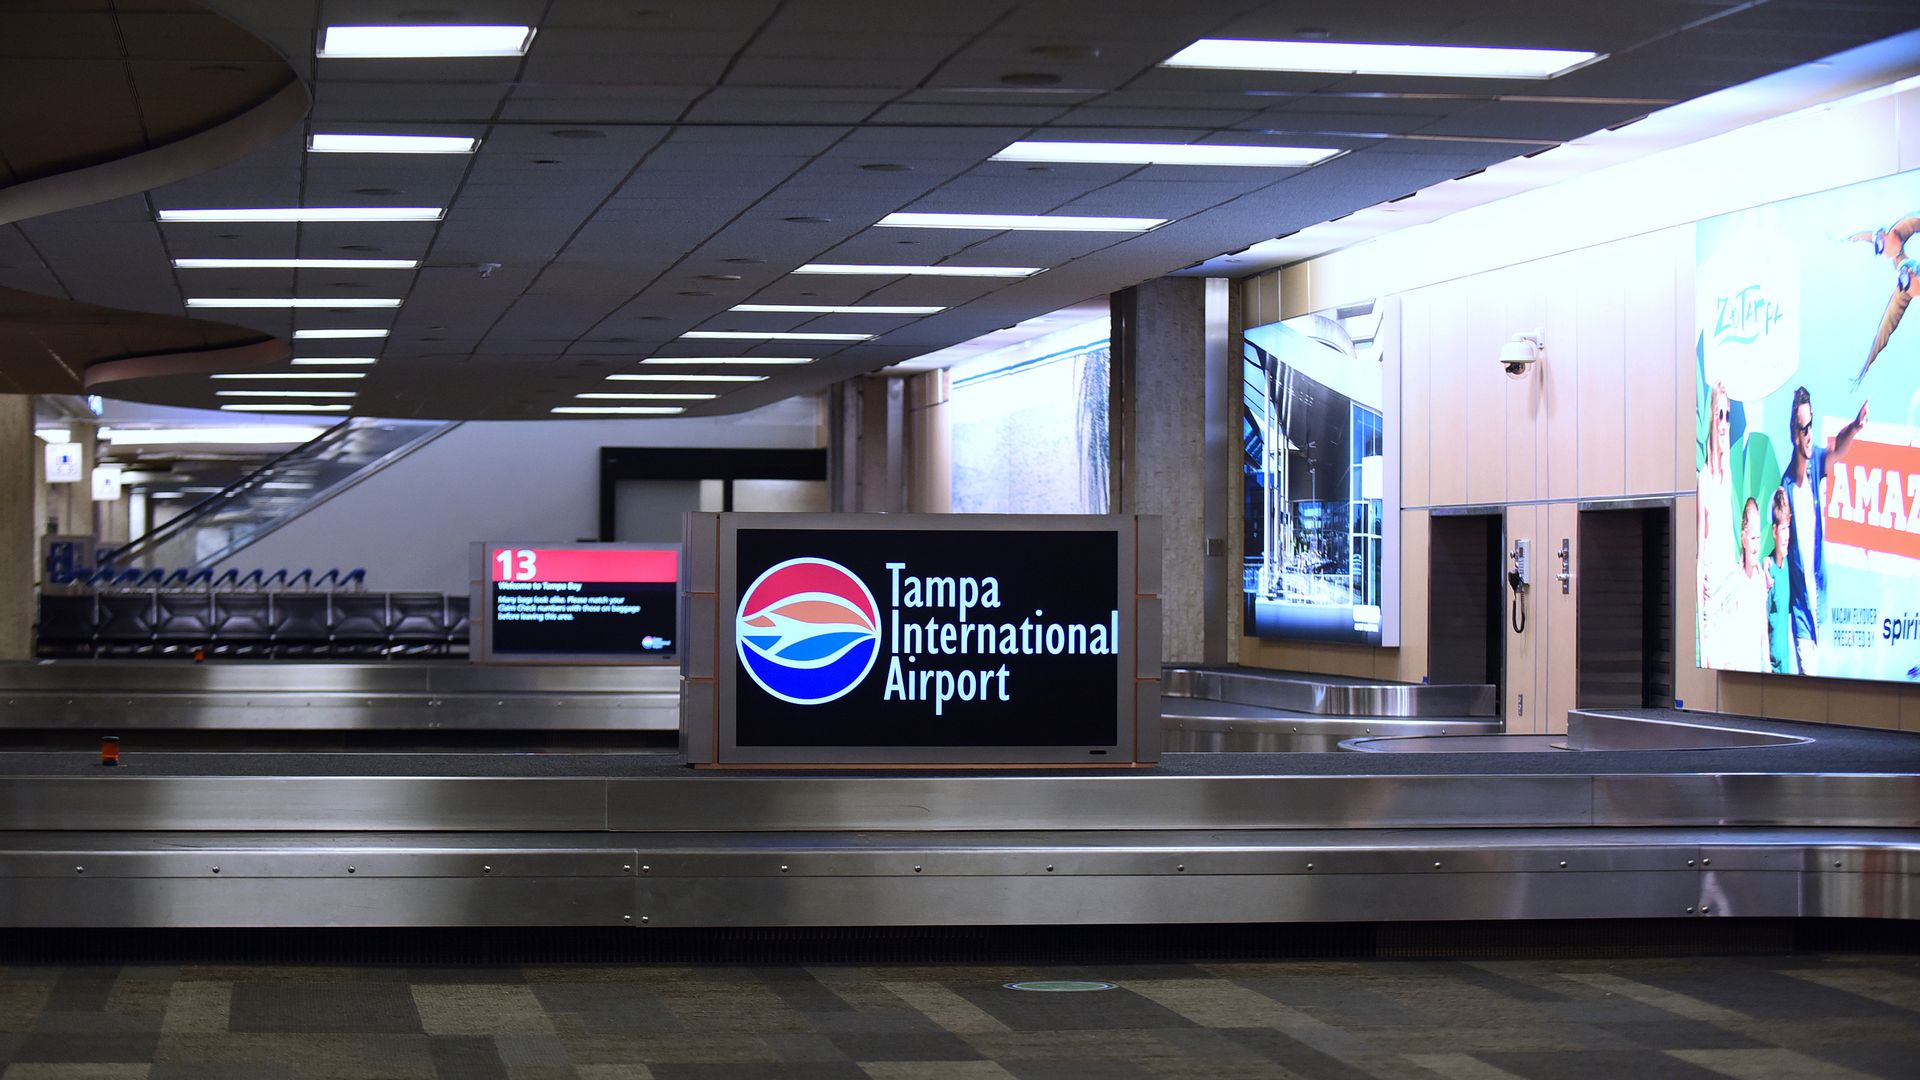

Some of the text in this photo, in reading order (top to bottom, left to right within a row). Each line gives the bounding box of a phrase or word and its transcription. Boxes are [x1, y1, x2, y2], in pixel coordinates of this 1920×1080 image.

[496, 550, 537, 580] 13
[498, 582, 582, 592] Welcome to Tampa Bay
[498, 596, 516, 604] Many
[518, 596, 533, 604] bags
[886, 562, 1001, 622] Tampa
[517, 604, 536, 612] Check
[612, 605, 640, 613] baggage
[521, 613, 544, 621] leaving
[891, 609, 1119, 655] International
[1883, 612, 1920, 646] spiri
[883, 655, 1010, 716] Airport
